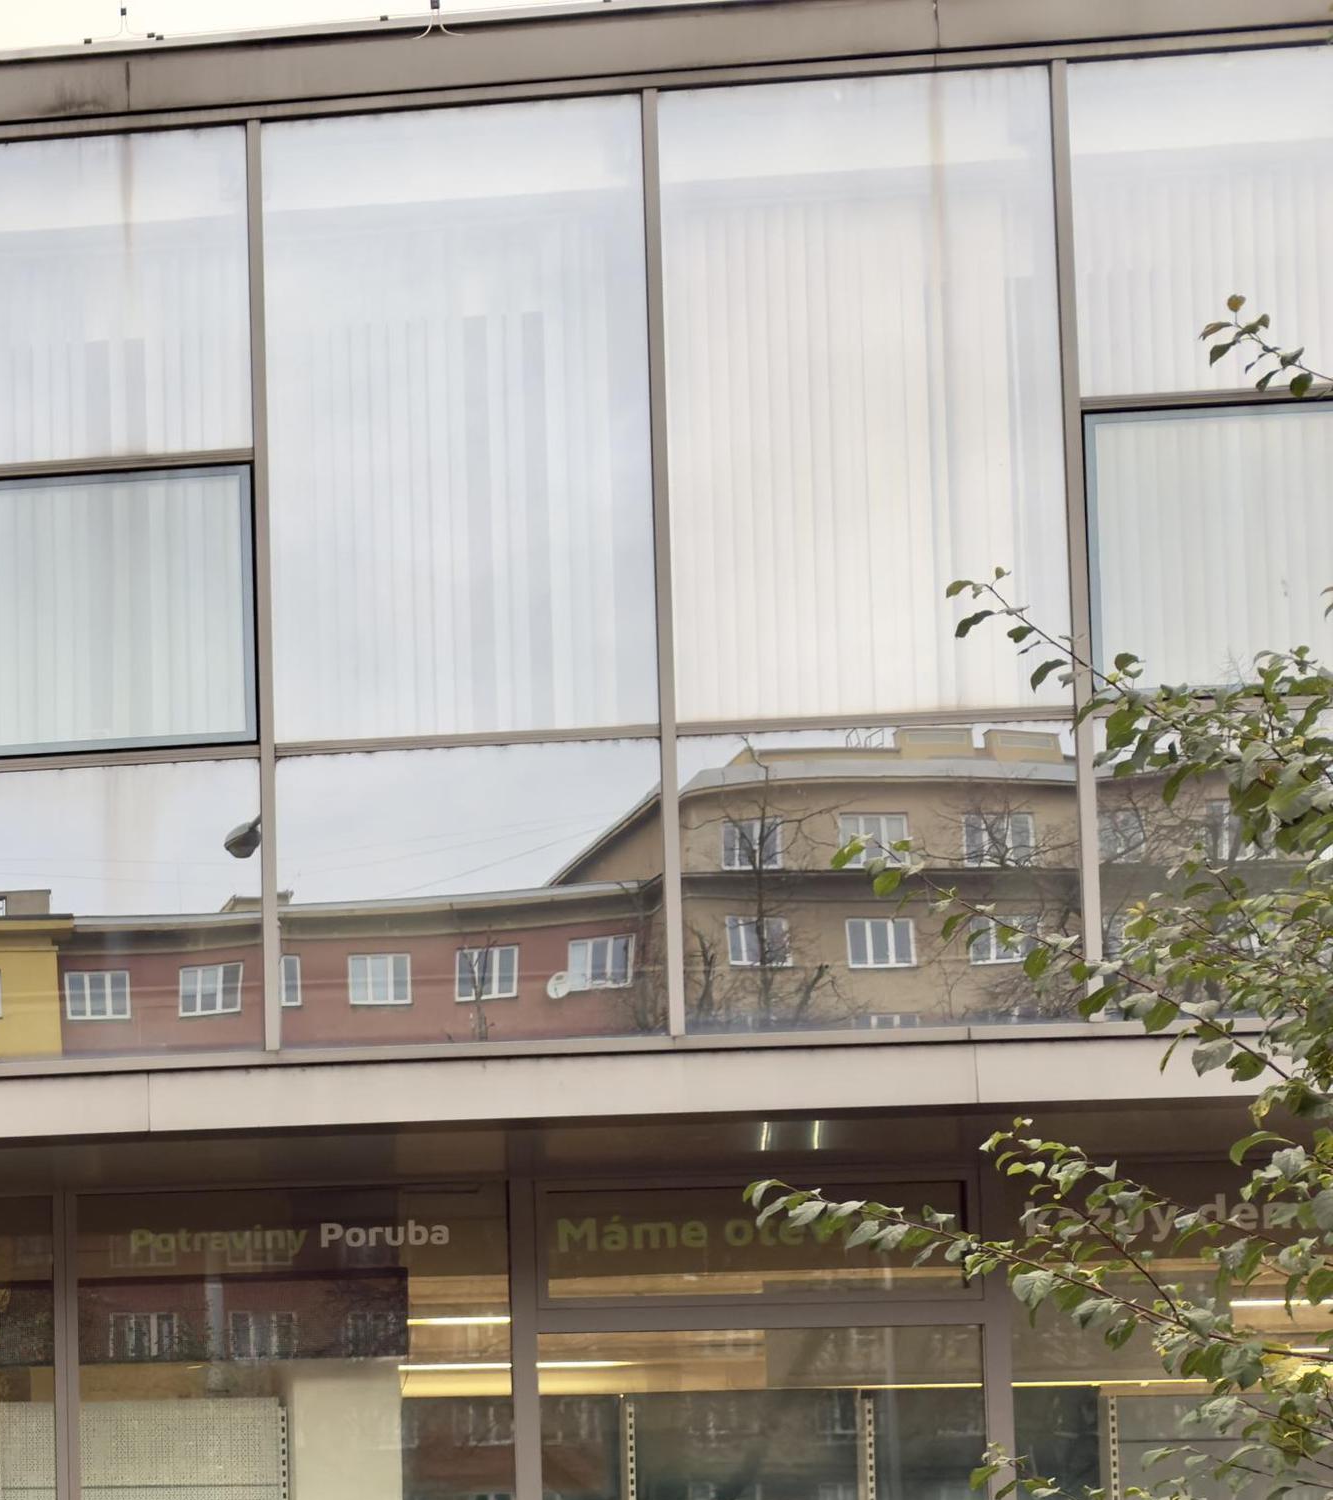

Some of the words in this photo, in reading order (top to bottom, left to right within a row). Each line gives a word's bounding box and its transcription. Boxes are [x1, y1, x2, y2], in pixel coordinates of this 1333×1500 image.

[130, 1224, 309, 1257] Potraviny
[320, 1219, 450, 1248] Poruba
[557, 1215, 708, 1254] Máme
